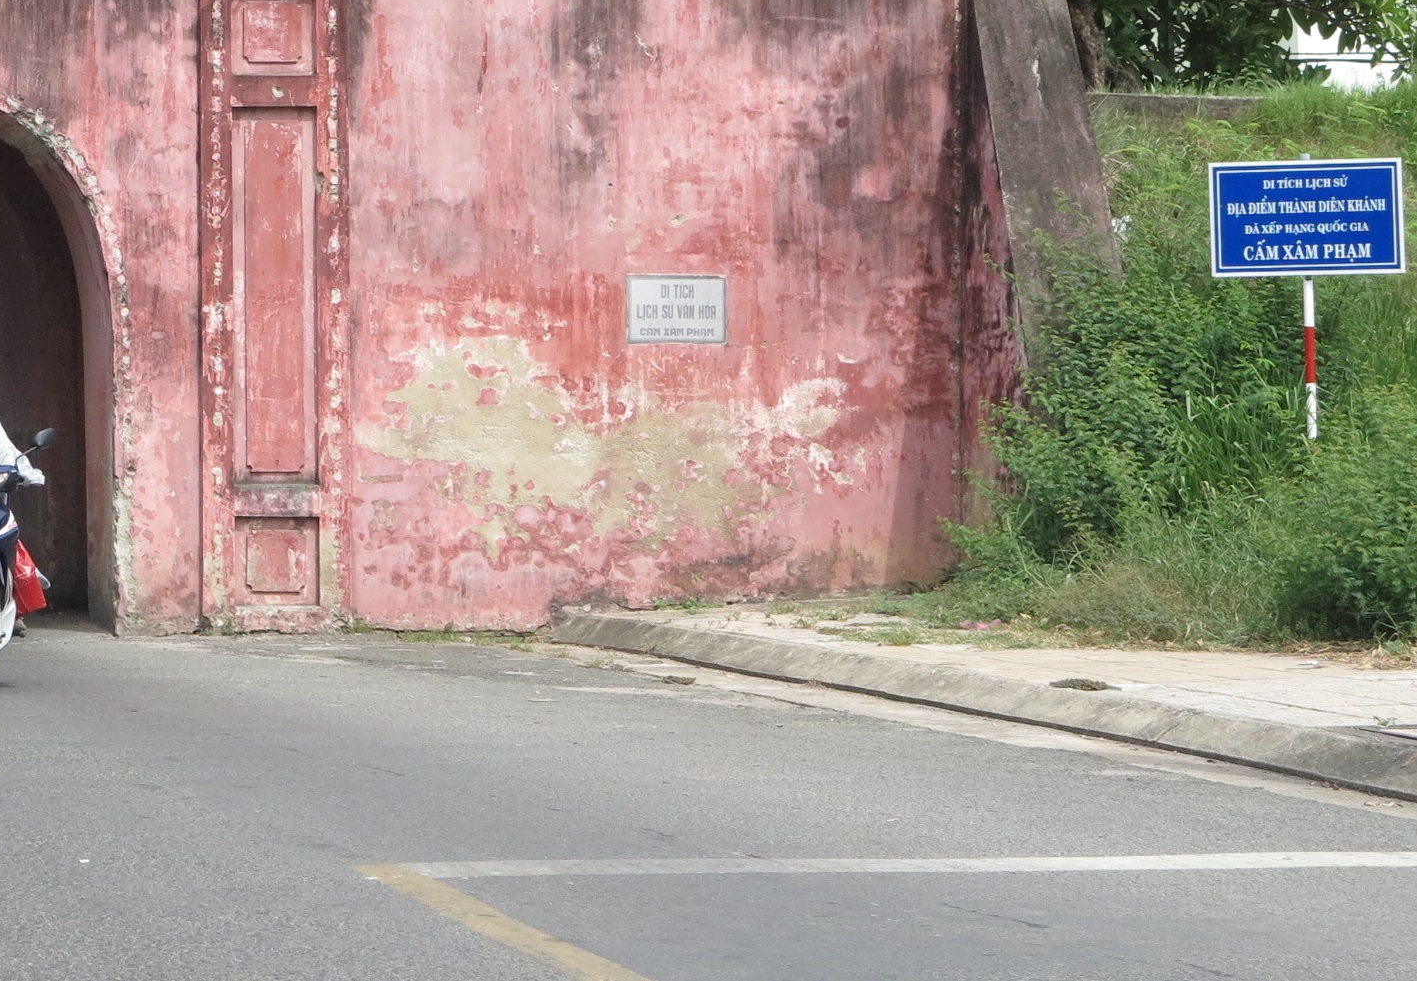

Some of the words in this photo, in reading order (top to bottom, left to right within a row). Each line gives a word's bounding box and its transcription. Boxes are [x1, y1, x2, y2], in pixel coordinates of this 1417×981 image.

[1263, 179, 1275, 189] DI
[1277, 177, 1303, 188] TÍCH
[1305, 178, 1331, 190] LỊCH
[1333, 174, 1348, 188] SỬ
[1227, 202, 1246, 218] ĐỊA
[1248, 195, 1276, 215] ĐIỂM
[1278, 197, 1316, 214] THÀNH
[1318, 196, 1345, 213] DIÊN
[1347, 195, 1386, 212] KHÁNH
[1244, 223, 1260, 235] ĐÃ
[1261, 221, 1283, 234] XẾP
[1285, 223, 1315, 235] HẠNG
[1317, 219, 1348, 234] QUỐC
[1349, 222, 1370, 232] GIA
[1244, 239, 1280, 261] CẤM
[1282, 240, 1319, 260] XÂM
[1323, 243, 1372, 262] PHẠM
[660, 284, 670, 299] DI
[636, 304, 658, 321] LỊCH
